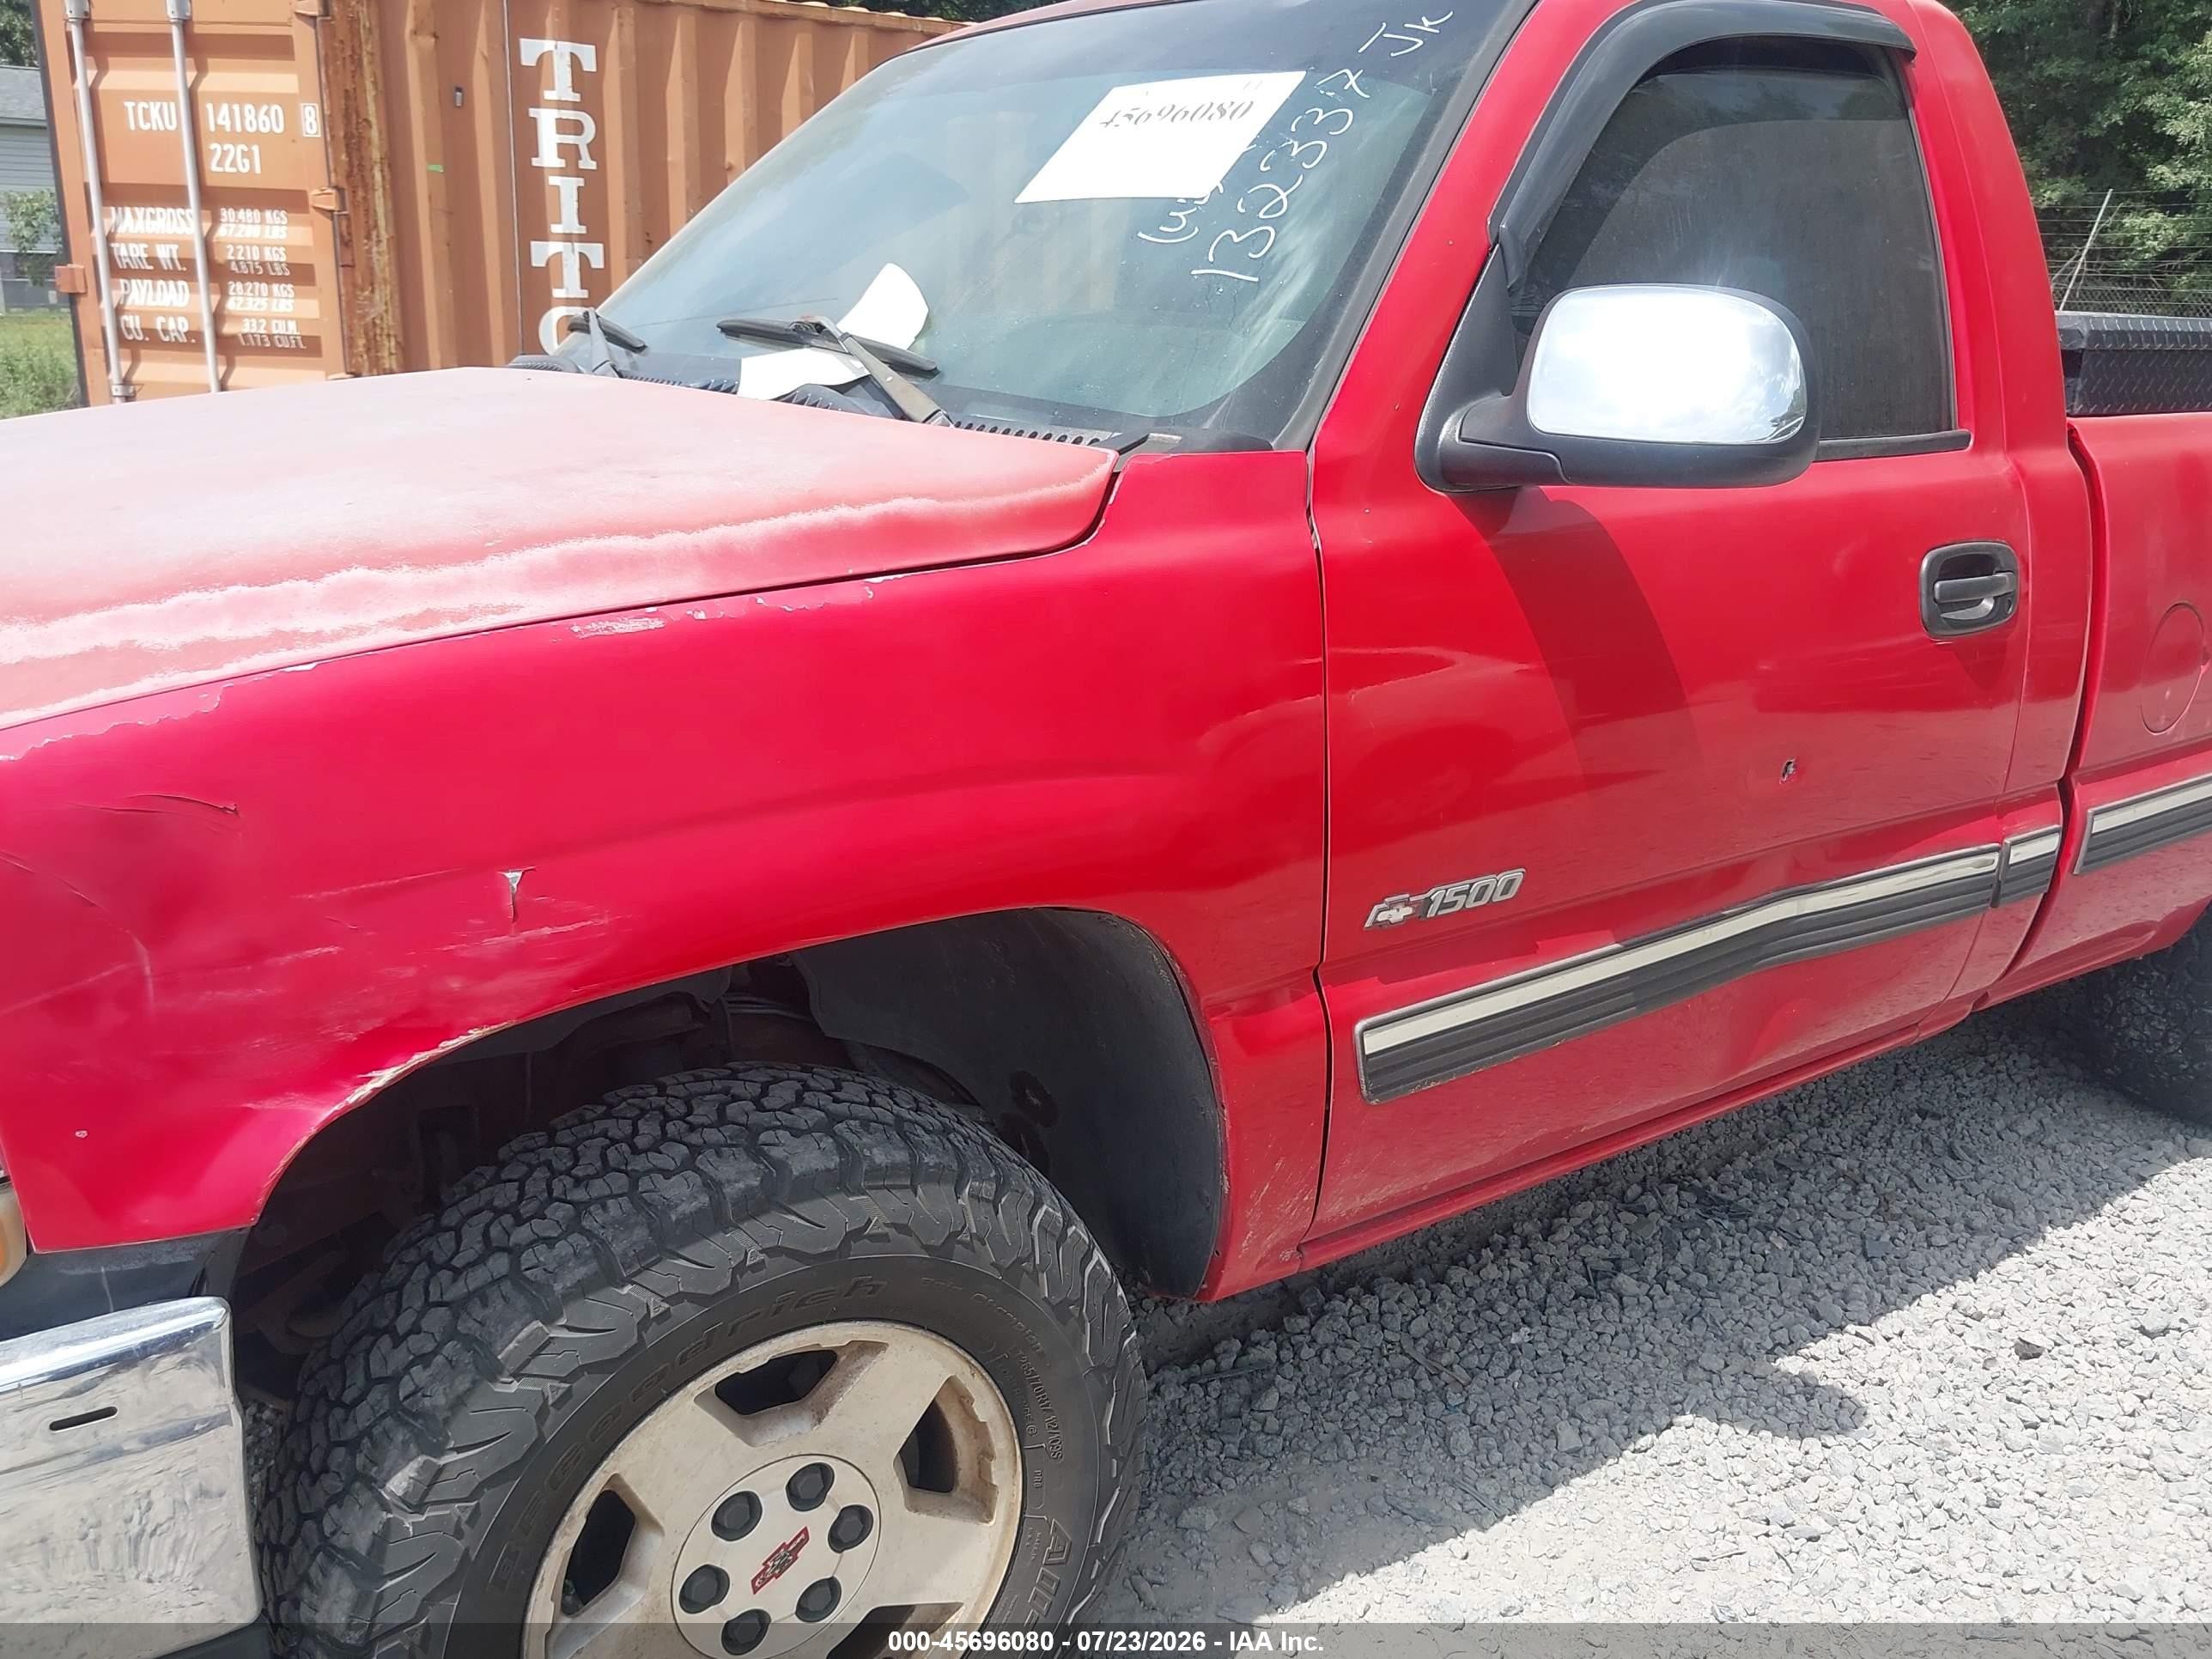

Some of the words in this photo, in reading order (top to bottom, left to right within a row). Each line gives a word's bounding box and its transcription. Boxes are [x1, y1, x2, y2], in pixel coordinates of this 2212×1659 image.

[124, 101, 178, 131] TCKU
[206, 102, 285, 134] 141860
[303, 105, 319, 136] 8
[210, 143, 262, 173] 22G1
[264, 210, 289, 225] KGS
[110, 243, 155, 270] TARE
[155, 244, 187, 271] WT.
[264, 246, 287, 262] KGS
[267, 261, 290, 276] LBS
[118, 278, 191, 307] PAYLOAD
[271, 283, 295, 298] KGS
[120, 315, 150, 341] CU.
[1426, 872, 1523, 919] 1500
